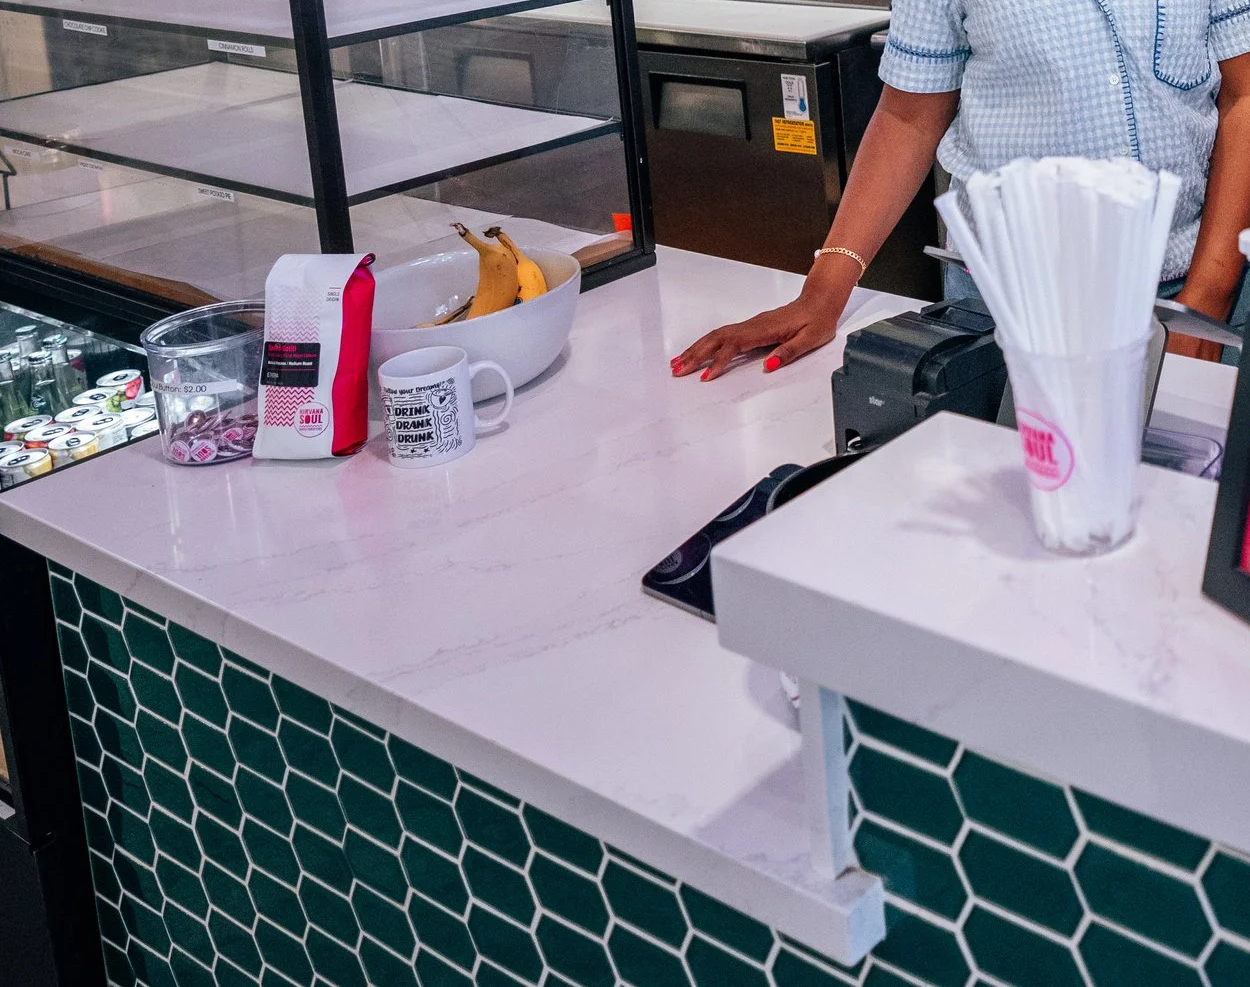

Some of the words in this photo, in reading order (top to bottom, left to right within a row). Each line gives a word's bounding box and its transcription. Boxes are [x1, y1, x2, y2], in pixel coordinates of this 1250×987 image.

[218, 42, 241, 52] CINNAMON
[241, 45, 254, 54] ROLLS
[159, 383, 181, 393] Button:
[184, 384, 207, 393] $2.00
[300, 407, 323, 415] NIRVANA
[395, 405, 430, 417] DRINK
[300, 414, 323, 424] SOUL
[396, 418, 432, 430] DRANK
[398, 431, 434, 443] DRUNK
